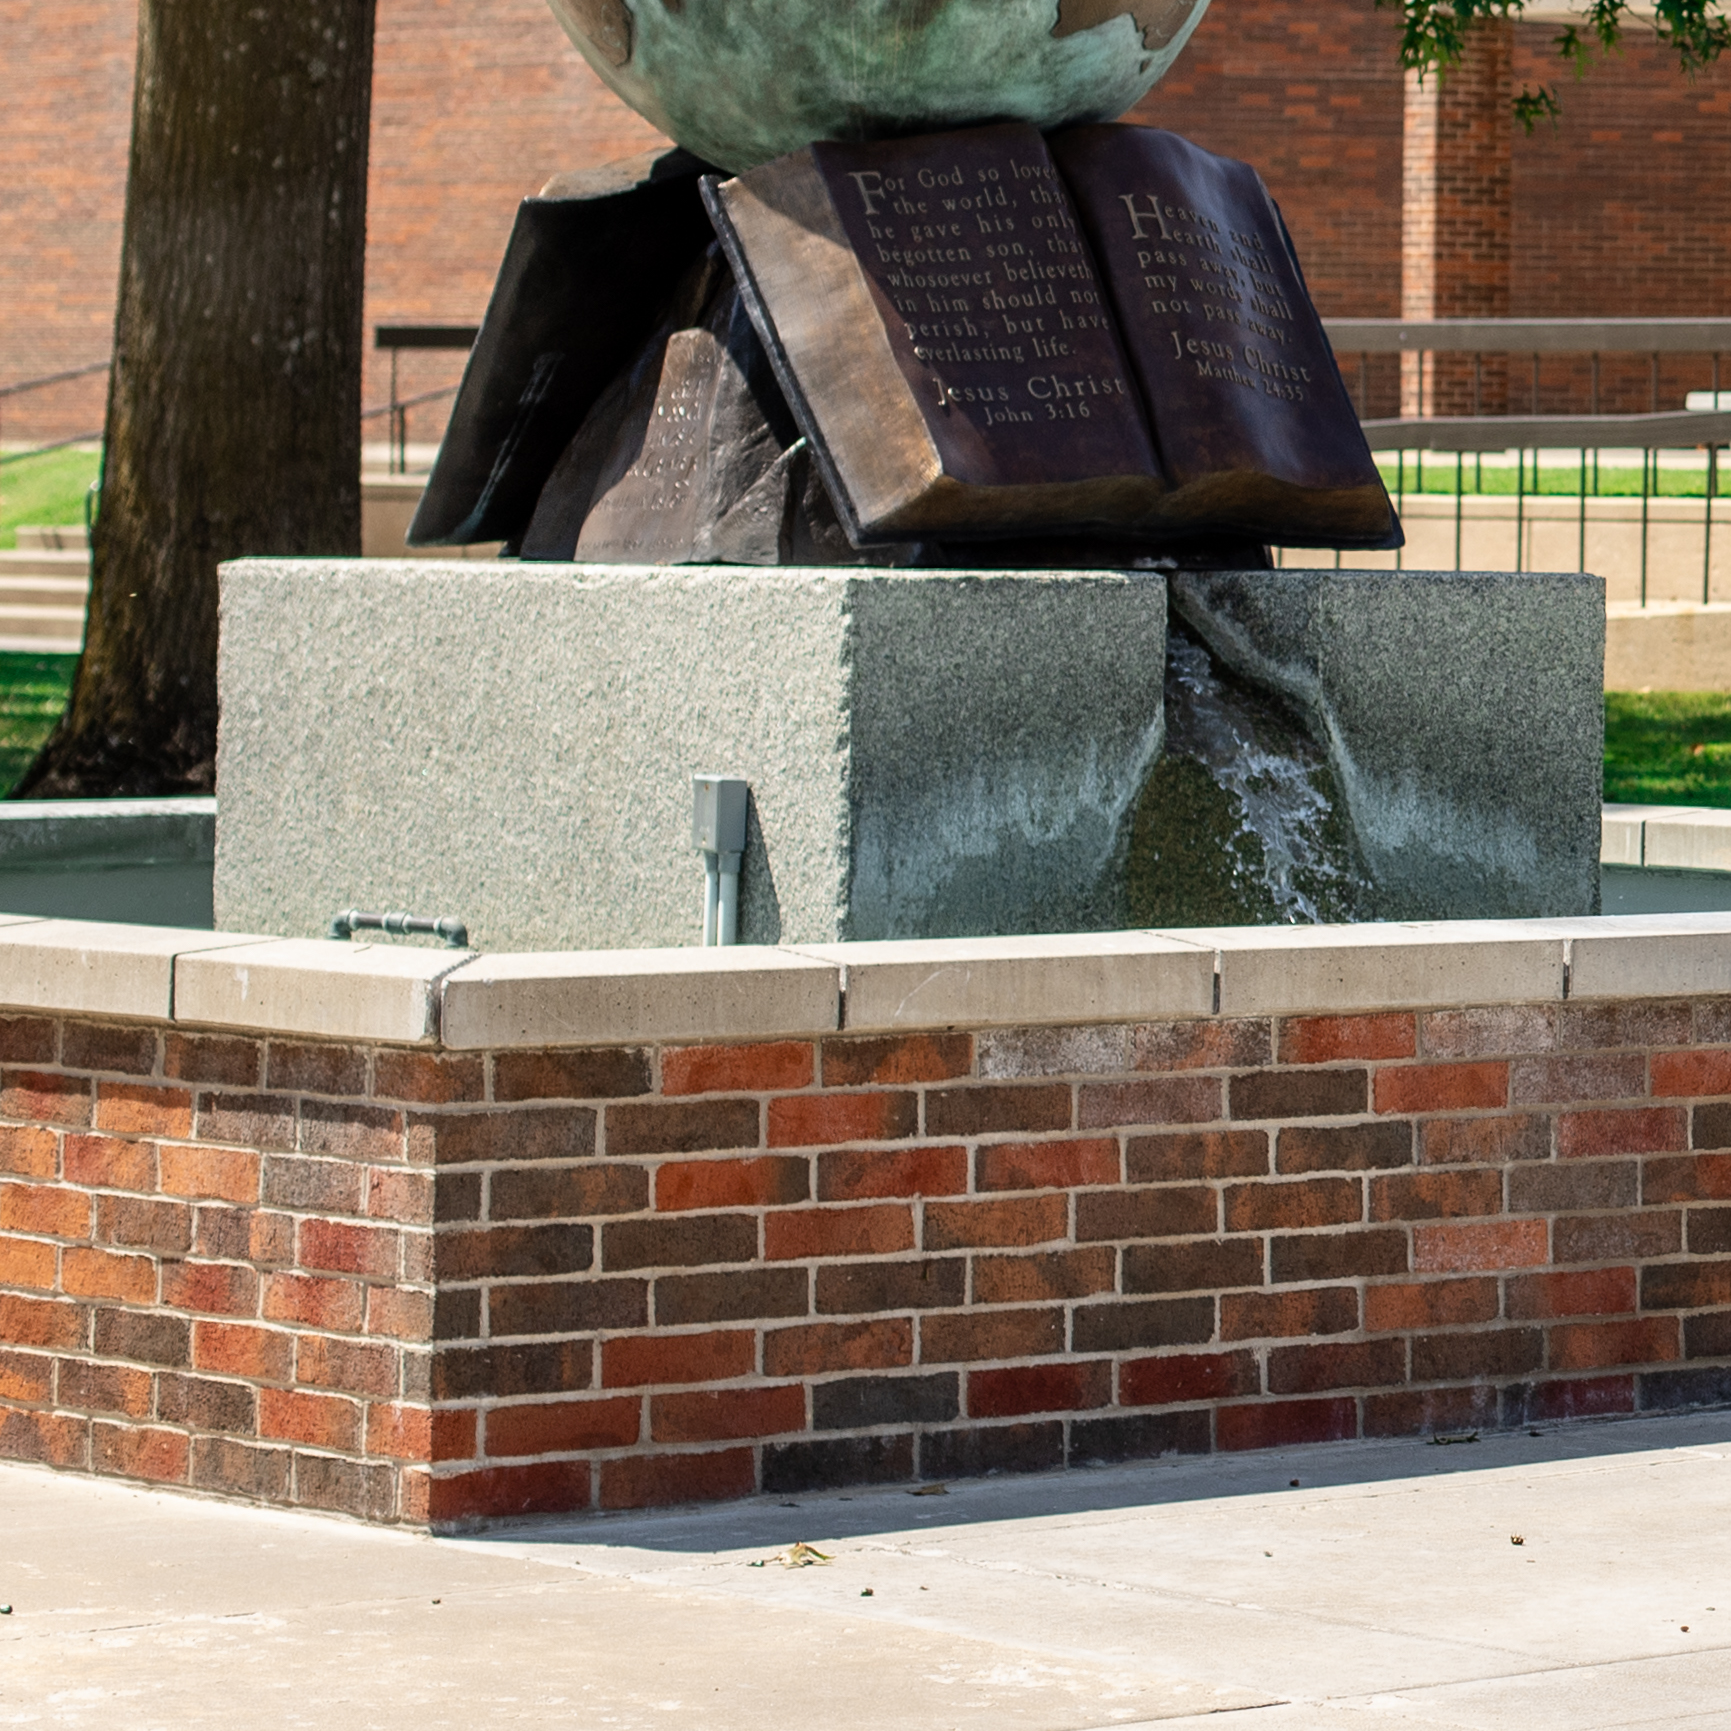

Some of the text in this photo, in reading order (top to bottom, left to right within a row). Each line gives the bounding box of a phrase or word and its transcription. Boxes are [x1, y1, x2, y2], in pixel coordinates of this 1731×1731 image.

[848, 158, 1060, 216] For God so loved
[893, 193, 928, 215] the
[942, 186, 1018, 212] world,
[867, 208, 1076, 244] he gave his only
[1118, 193, 1266, 252] Heaven and
[875, 241, 972, 267] begotten
[985, 241, 1035, 259] son,
[1172, 229, 1275, 274] earth shall
[887, 259, 1095, 289] whosoever believeth
[1137, 250, 1284, 299] pass away, but
[896, 293, 918, 313] in
[926, 292, 970, 314] him
[981, 284, 1058, 312] should
[1144, 273, 1294, 321] my words shall
[904, 308, 1110, 341] perish, but have
[1151, 297, 1293, 347] not pass away.
[912, 336, 1077, 364] everlasting life.
[1170, 330, 1312, 384] Jesus Christ
[931, 373, 1127, 407] Jesus Christ
[1194, 358, 1305, 403] Matthew 24:35
[983, 401, 1091, 427] John 3:16
